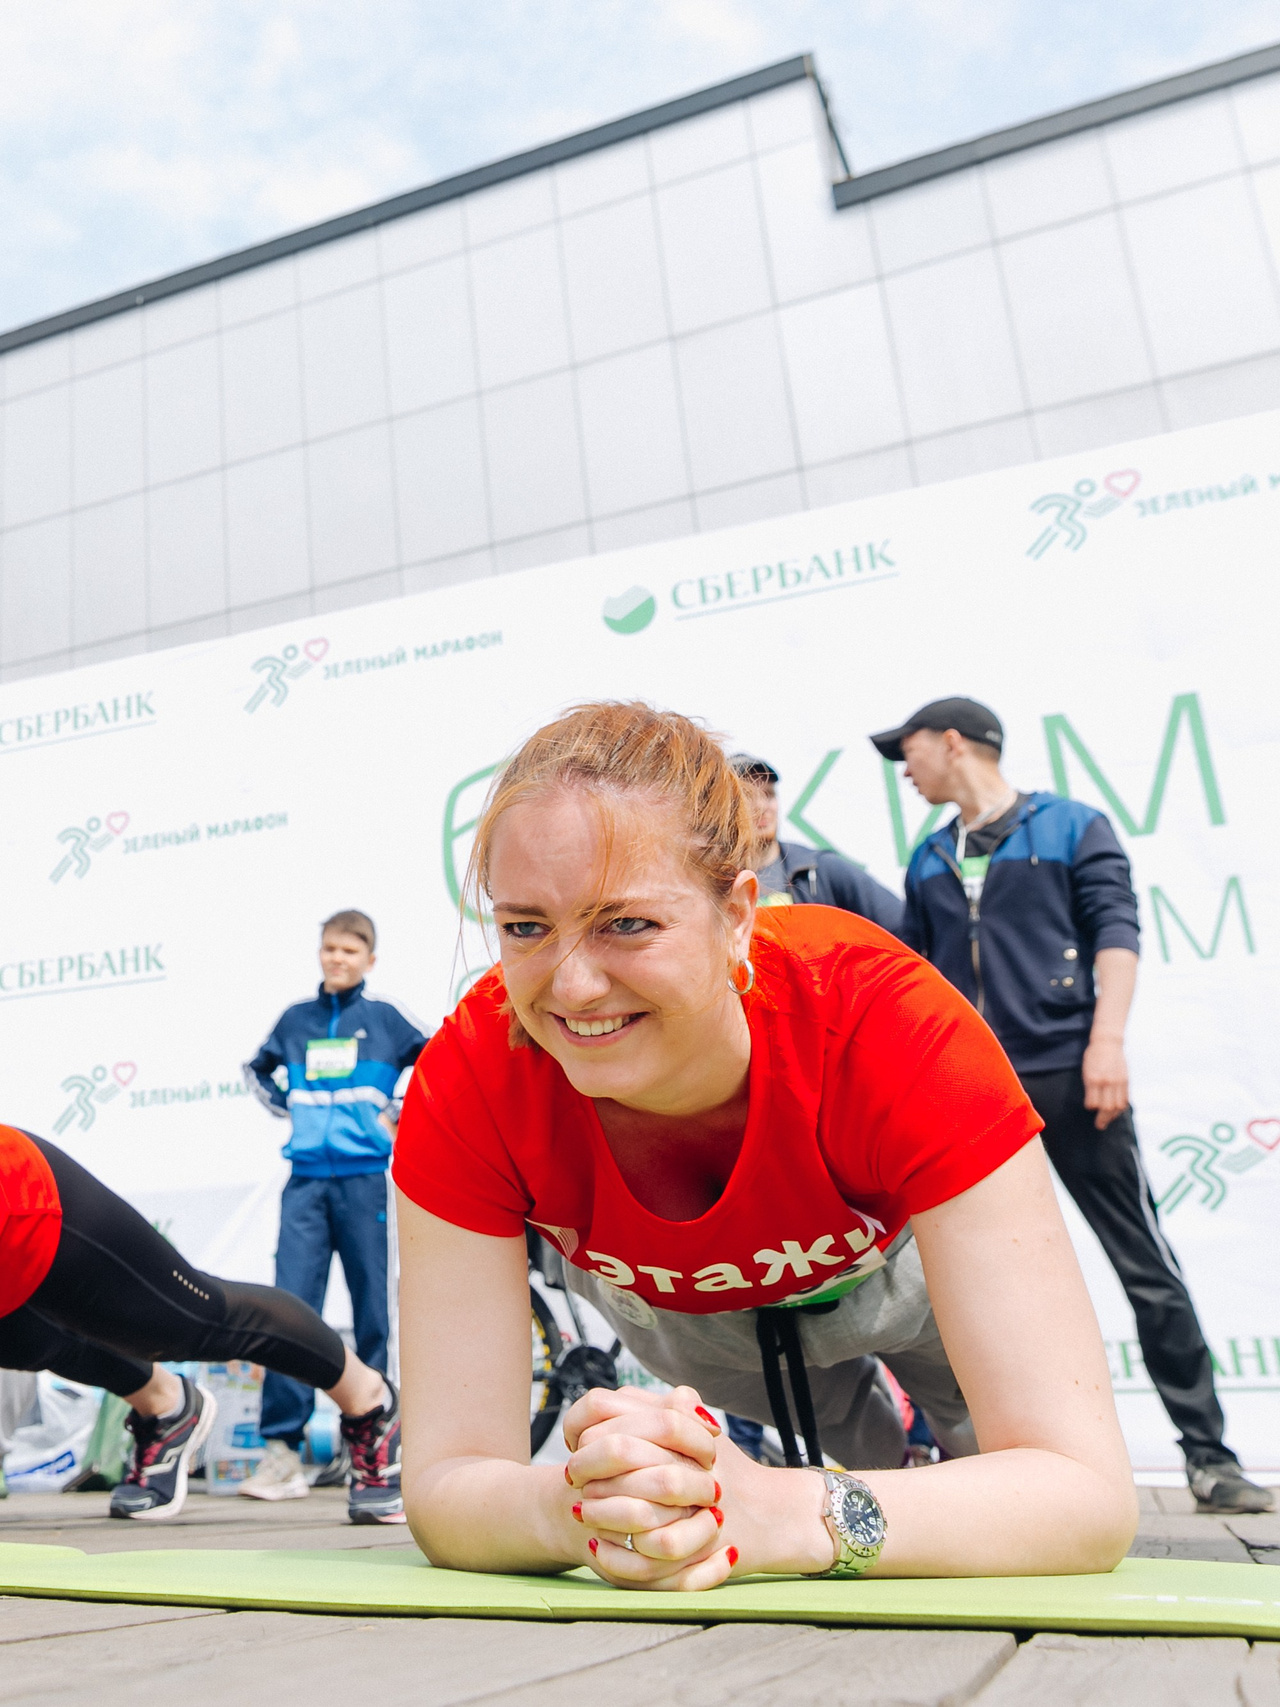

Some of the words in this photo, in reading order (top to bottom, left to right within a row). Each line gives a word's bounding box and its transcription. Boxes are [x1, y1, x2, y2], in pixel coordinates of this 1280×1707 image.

[671, 538, 898, 610] СБЕРБАНК
[413, 630, 504, 662] МАРАФОН
[206, 812, 289, 841] МАРАФОН
